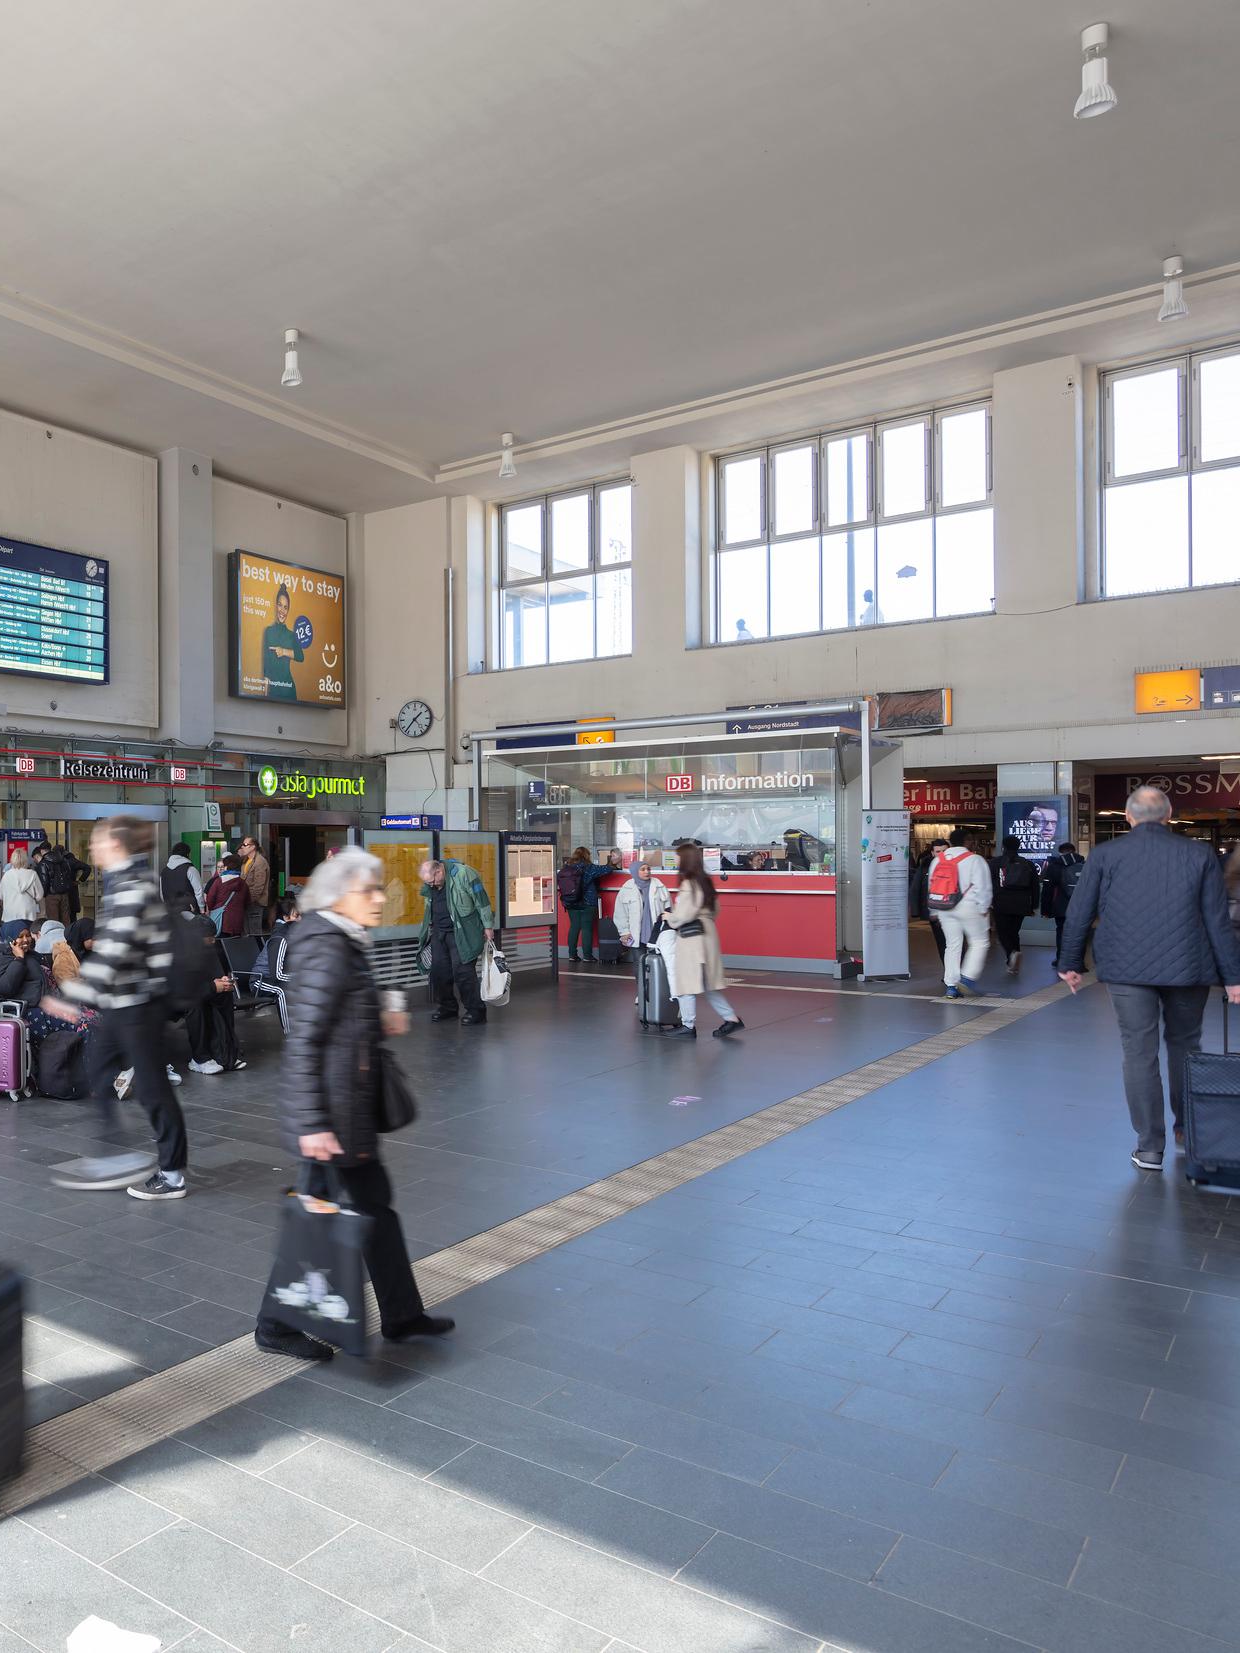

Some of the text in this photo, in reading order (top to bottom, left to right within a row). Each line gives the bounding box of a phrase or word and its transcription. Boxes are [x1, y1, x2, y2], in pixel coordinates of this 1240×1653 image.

[242, 559, 340, 603] best way to stay
[255, 609, 266, 618] way
[41, 626, 62, 634] Düsseldorf
[296, 624, 311, 639] 12 €
[319, 675, 341, 693] a&o
[20, 759, 150, 780] DB Reisezentrum
[174, 768, 186, 779] DB
[668, 771, 814, 791] DB Information
[926, 784, 950, 800] im
[924, 803, 936, 811] im
[940, 802, 960, 812] Jahr
[964, 801, 979, 810] für
[1018, 841, 1056, 849] ATUR?
